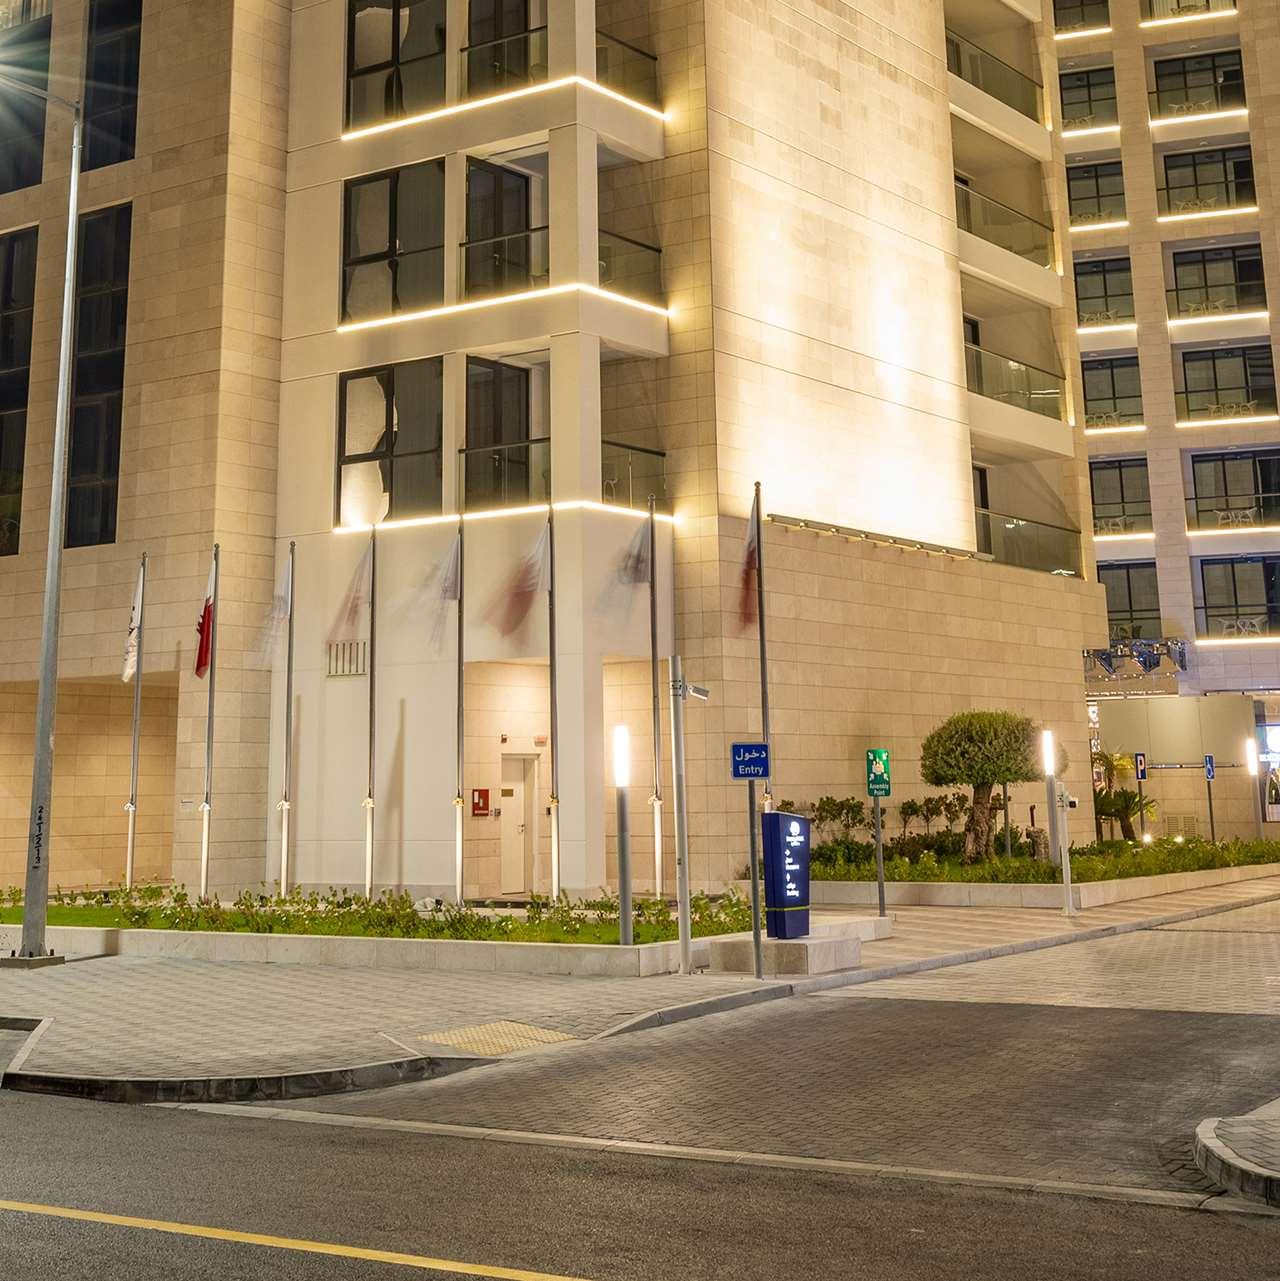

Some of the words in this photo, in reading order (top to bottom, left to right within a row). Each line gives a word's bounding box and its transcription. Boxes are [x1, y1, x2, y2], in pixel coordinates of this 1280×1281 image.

[735, 748, 767, 761] دخول
[738, 765, 764, 776] Entry
[1137, 755, 1145, 778] P
